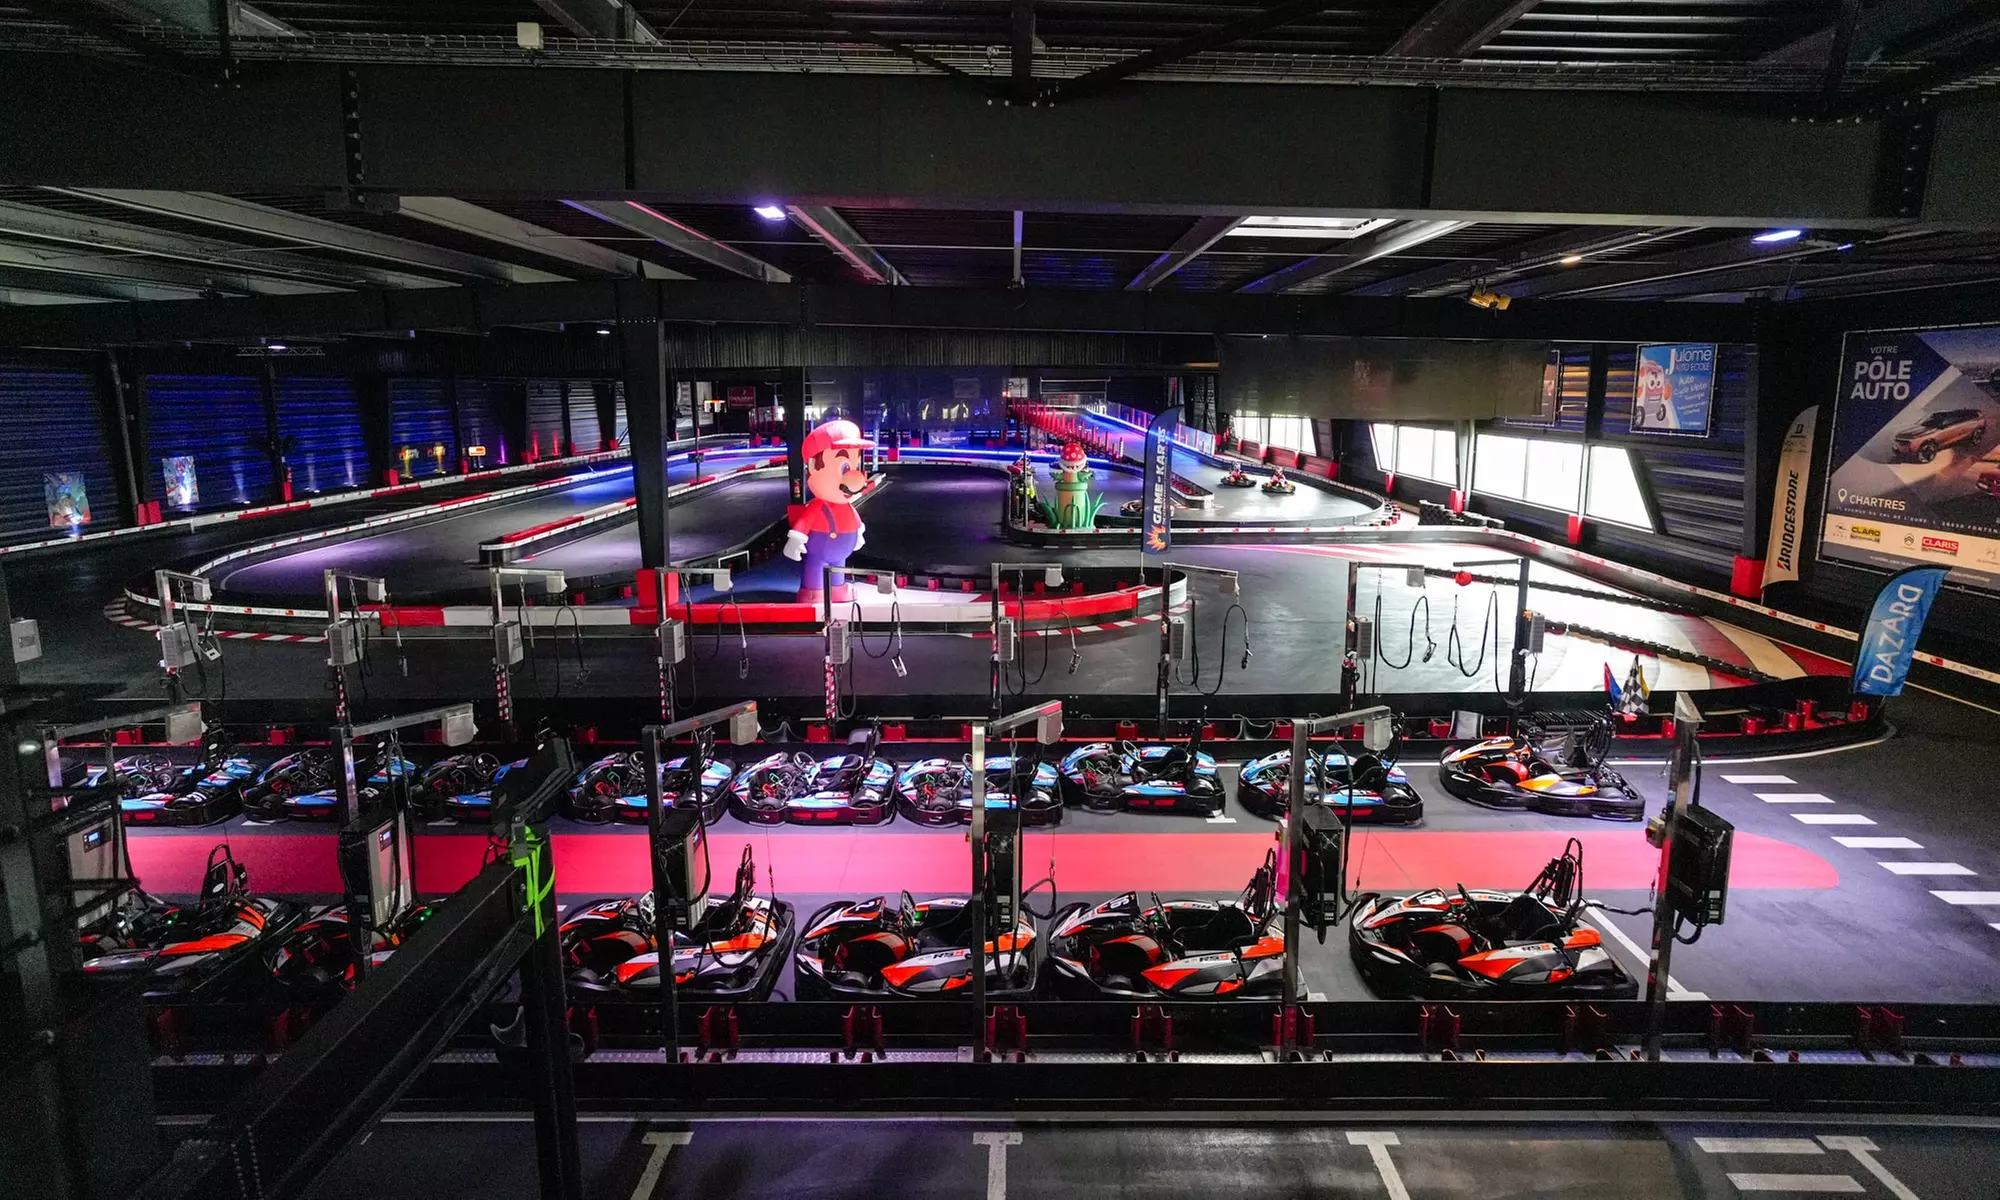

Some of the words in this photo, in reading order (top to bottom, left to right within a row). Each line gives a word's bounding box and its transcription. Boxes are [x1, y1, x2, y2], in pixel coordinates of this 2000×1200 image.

[1870, 346, 1899, 354] VOTRE
[1665, 348, 1712, 375] Julome
[1854, 356, 1913, 380] PÔLE
[1850, 382, 1910, 400] AUTO
[1849, 494, 1906, 511] CHARTRES
[1777, 470, 1799, 571] BRIDGESTONE
[1851, 527, 1881, 537] CLARO
[1923, 539, 1958, 550] CLARIS
[1870, 584, 1924, 684] DAZARD
